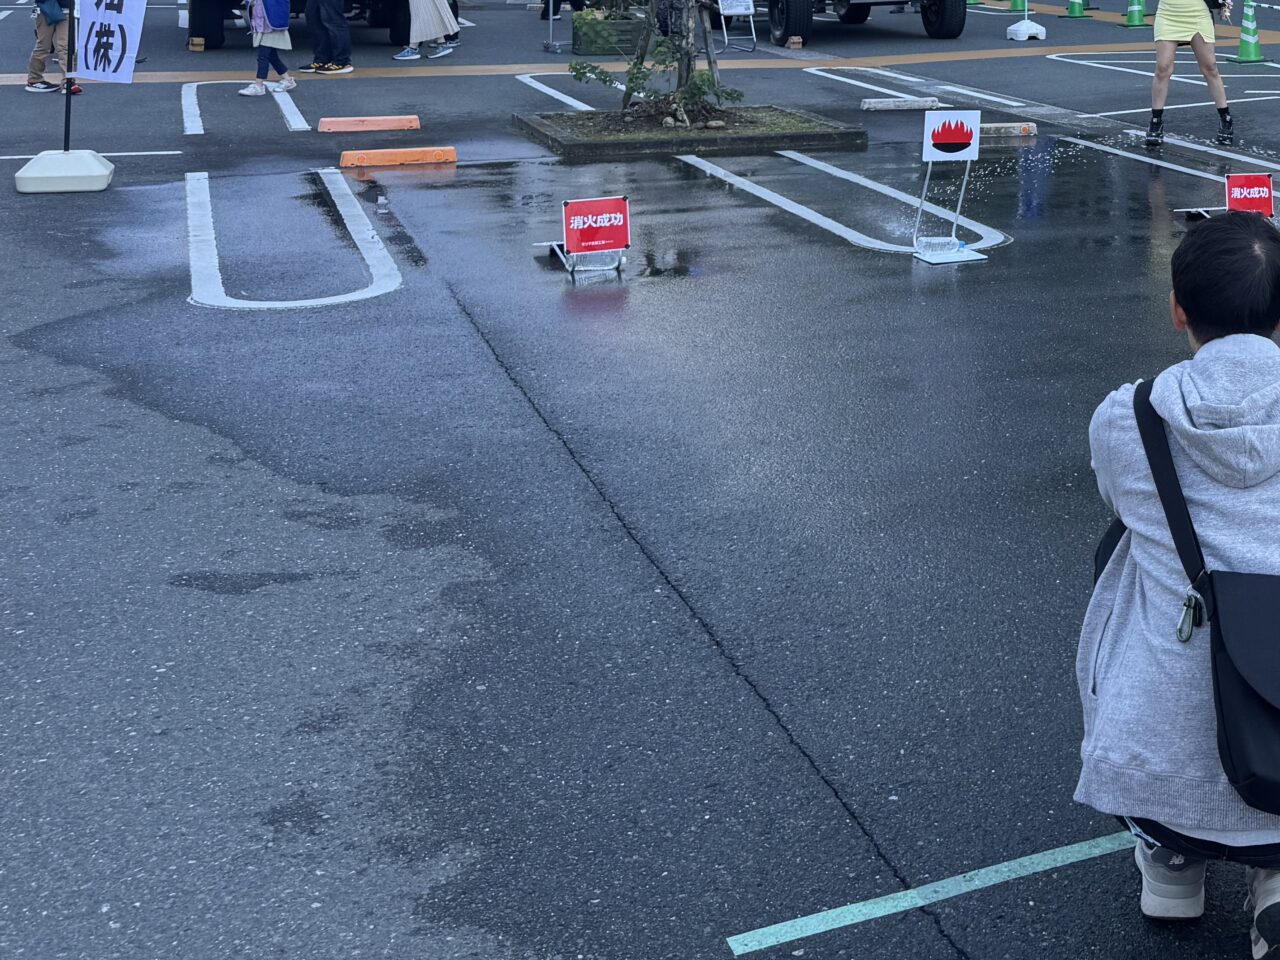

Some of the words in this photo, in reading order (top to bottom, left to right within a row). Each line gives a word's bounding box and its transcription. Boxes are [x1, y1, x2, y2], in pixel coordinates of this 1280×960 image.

[1231, 186, 1269, 199] 消火成功
[569, 212, 624, 230] 消火成功
